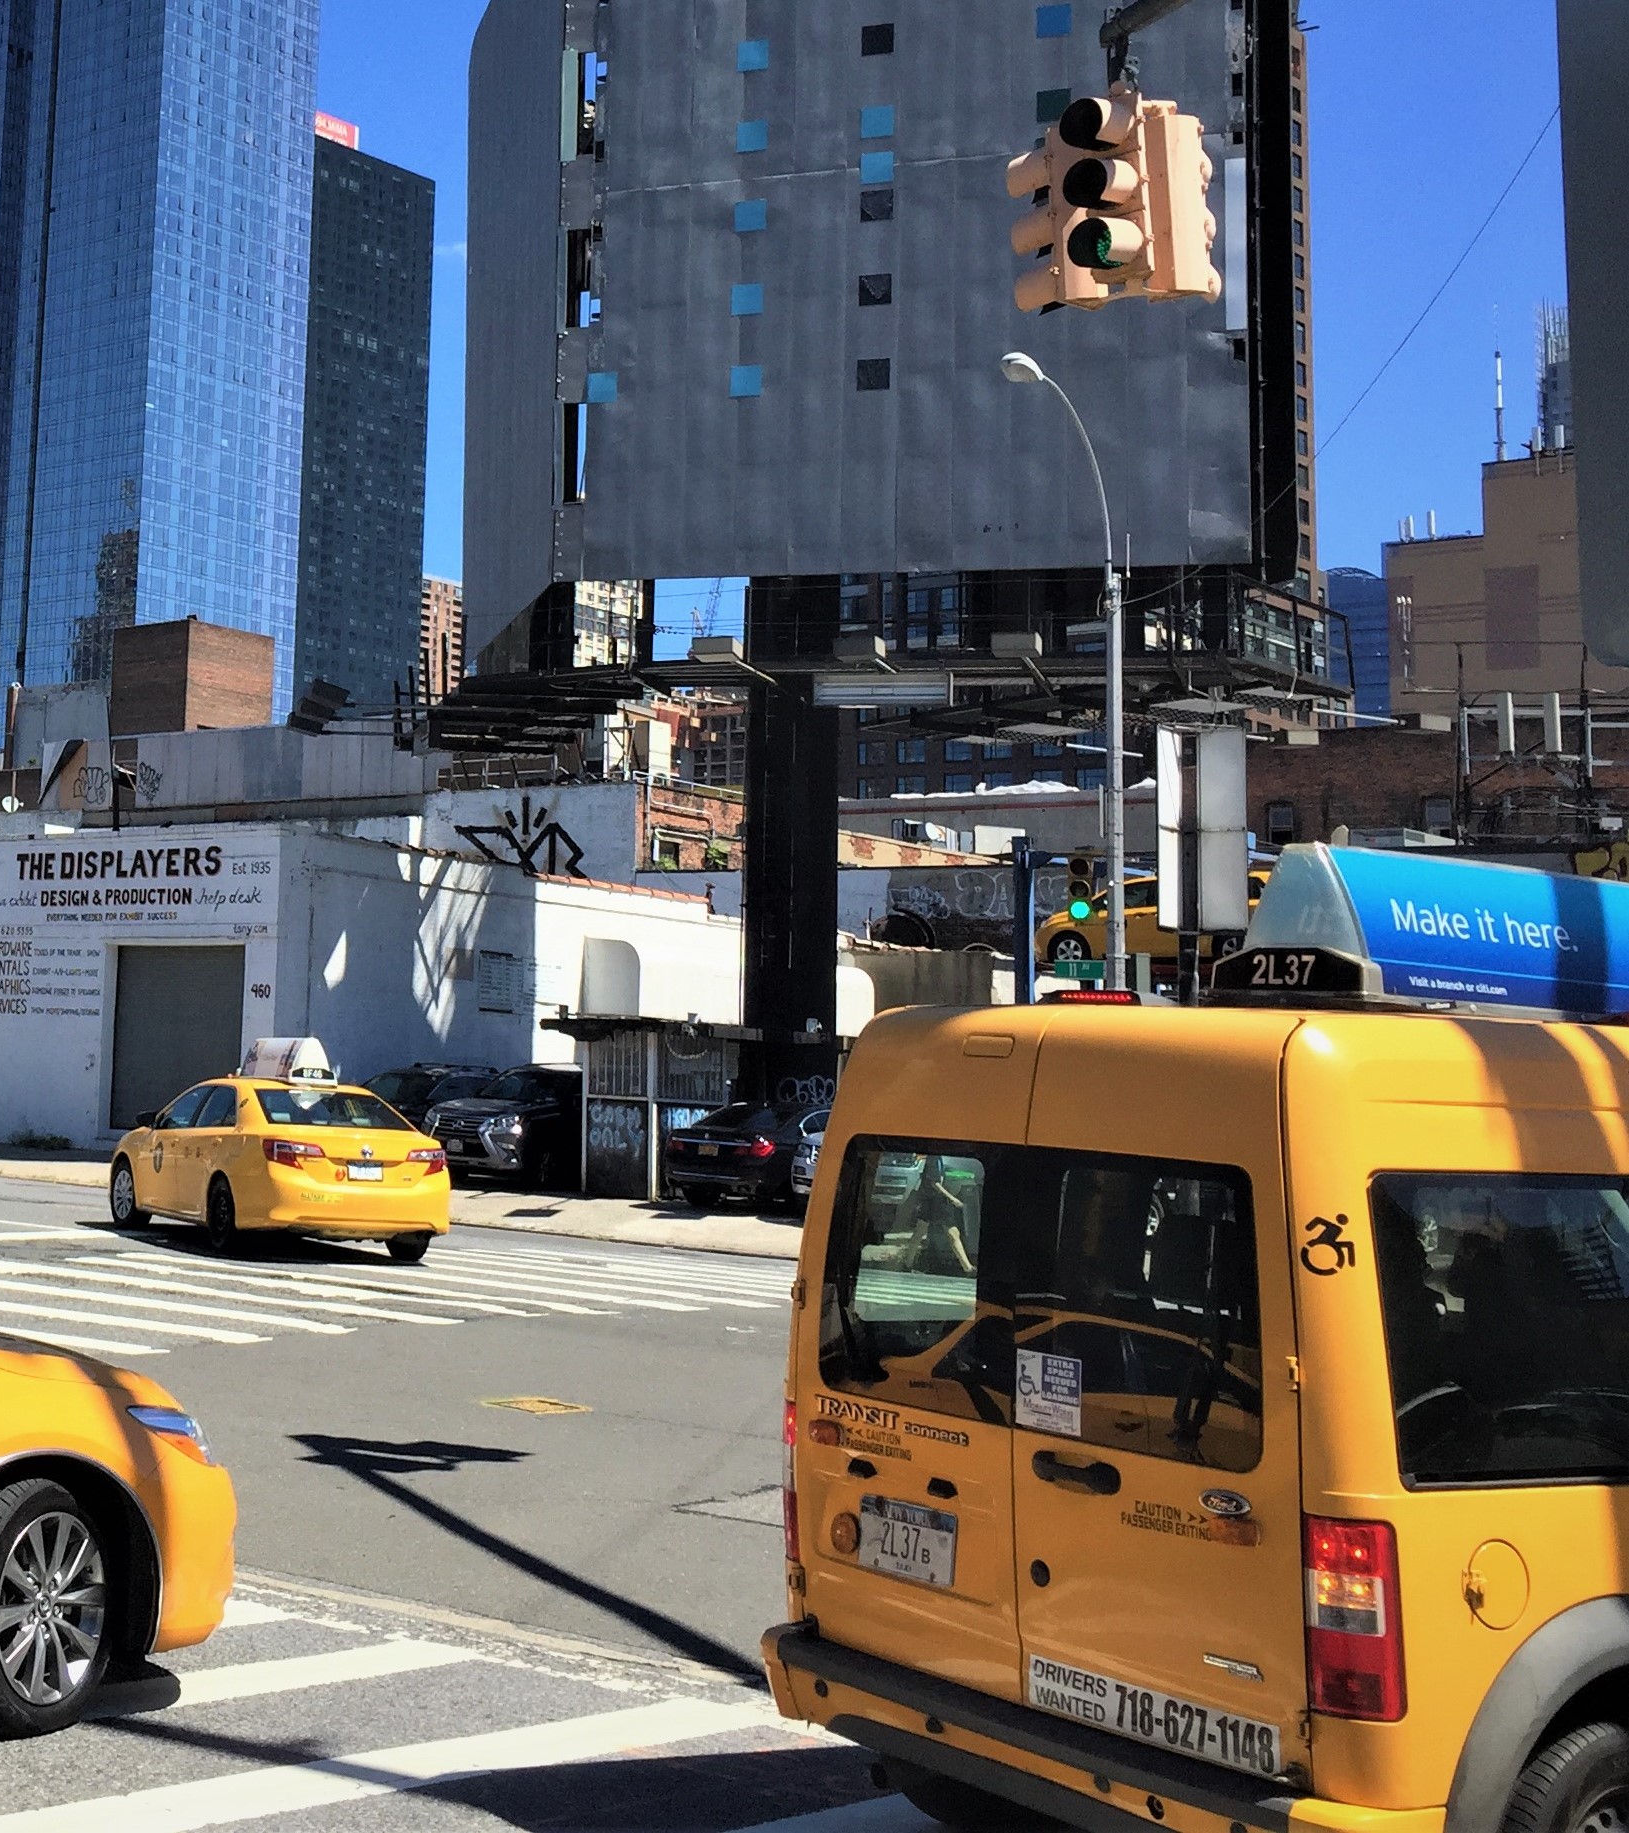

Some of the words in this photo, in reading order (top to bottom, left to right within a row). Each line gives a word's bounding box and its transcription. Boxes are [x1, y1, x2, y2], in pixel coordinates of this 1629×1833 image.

[17, 852, 56, 880] THE
[60, 845, 222, 880] DISPLAYERS
[40, 890, 90, 907] DESIGN
[92, 889, 102, 907] &
[104, 887, 192, 906] PRODUCTION
[229, 886, 262, 904] desk
[81, 912, 103, 922] NEEDED
[105, 912, 117, 921] FOR
[147, 911, 178, 921] SUCCESS
[1389, 898, 1472, 940] Make
[1475, 907, 1501, 944] it
[1503, 911, 1580, 953] here.
[1250, 955, 1317, 986] 2L37
[250, 983, 271, 999] 460
[1408, 975, 1430, 988] Visit
[1046, 1357, 1075, 1370] EXTRA
[1046, 1366, 1075, 1378] SPACE
[1044, 1374, 1078, 1388] NEEDED
[1052, 1385, 1069, 1395] FOR
[1041, 1390, 1079, 1405] LOADING
[814, 1393, 900, 1430] TRANSIT
[903, 1421, 970, 1447] connect
[1134, 1500, 1182, 1521] CAUTION
[1120, 1511, 1173, 1534] PASSENGER
[1175, 1524, 1211, 1542] EXITING
[880, 1521, 921, 1562] 2L37
[921, 1548, 931, 1564] B
[1033, 1658, 1108, 1698] DRIVERS
[1034, 1685, 1106, 1723] WANTED
[1114, 1684, 1274, 1774] 718-627-1148
